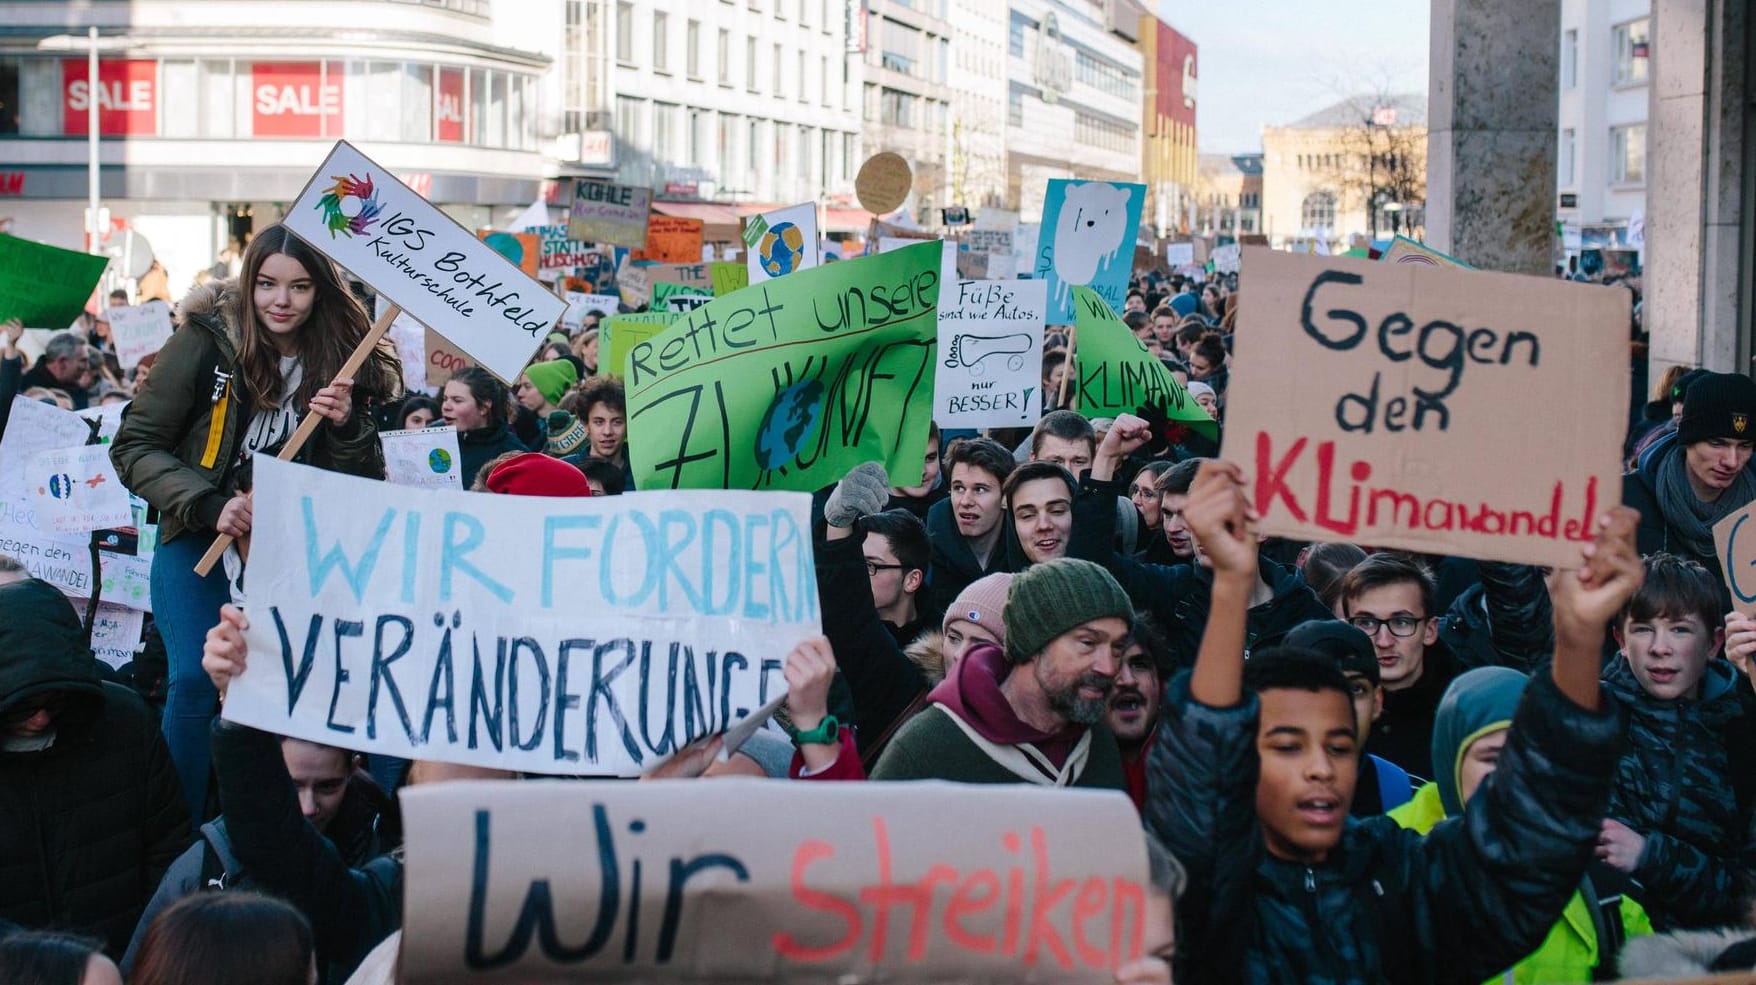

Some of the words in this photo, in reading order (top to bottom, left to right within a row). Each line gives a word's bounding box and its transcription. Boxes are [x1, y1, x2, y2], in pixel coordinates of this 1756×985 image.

[68, 79, 152, 111] SALE
[255, 83, 340, 115] SALE
[438, 93, 463, 123] SAL
[576, 180, 632, 207] KOHLE
[366, 236, 474, 318] Kulturschule
[380, 212, 435, 251] IGS
[434, 252, 549, 338] Bothfeld
[674, 265, 707, 281] THE
[958, 281, 1015, 309] Füße
[631, 287, 784, 387] Rettet
[813, 270, 937, 332] unsere
[938, 307, 963, 321] sind
[969, 310, 988, 321] wie
[993, 304, 1039, 321] Autos.
[1301, 270, 1540, 399] Gegen
[971, 381, 996, 390] nur
[1335, 372, 1450, 434] den
[45, 541, 71, 560] den
[301, 495, 514, 603] WIR
[542, 508, 820, 624] FORDERN
[464, 803, 750, 972] Wir
